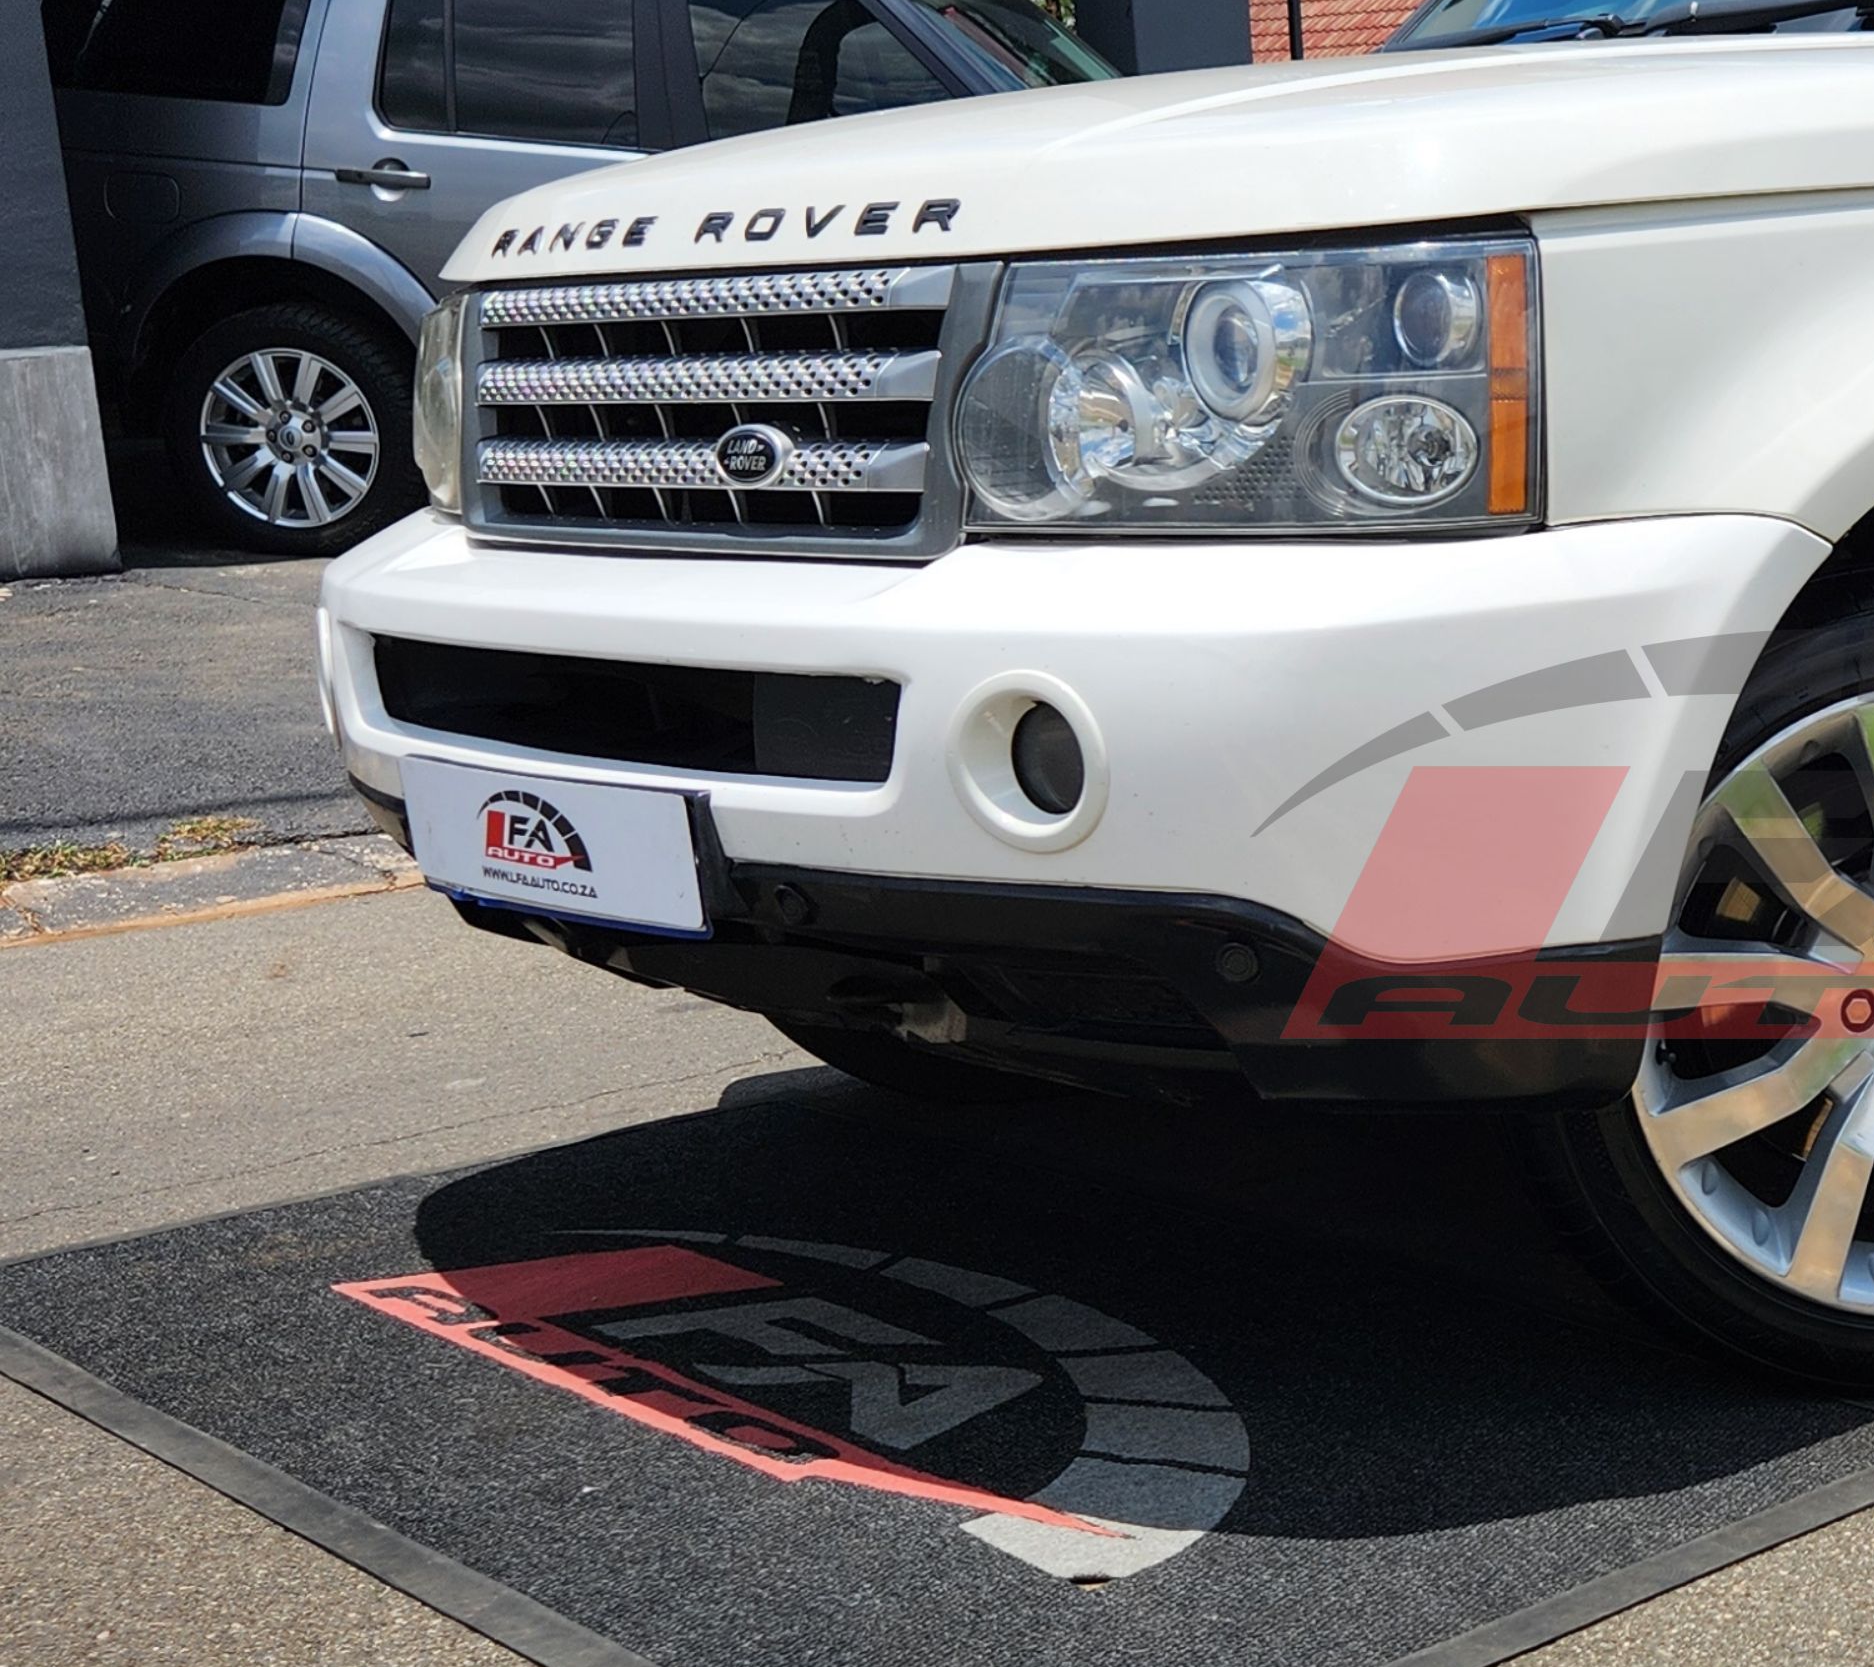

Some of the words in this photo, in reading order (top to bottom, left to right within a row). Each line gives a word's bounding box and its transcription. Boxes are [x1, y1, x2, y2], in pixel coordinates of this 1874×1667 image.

[491, 215, 658, 258] RANGE
[694, 198, 961, 244] ROVER
[727, 439, 758, 454] LAND
[729, 456, 767, 471] ROVER
[485, 810, 555, 858] LFA
[487, 846, 555, 867] AUTO
